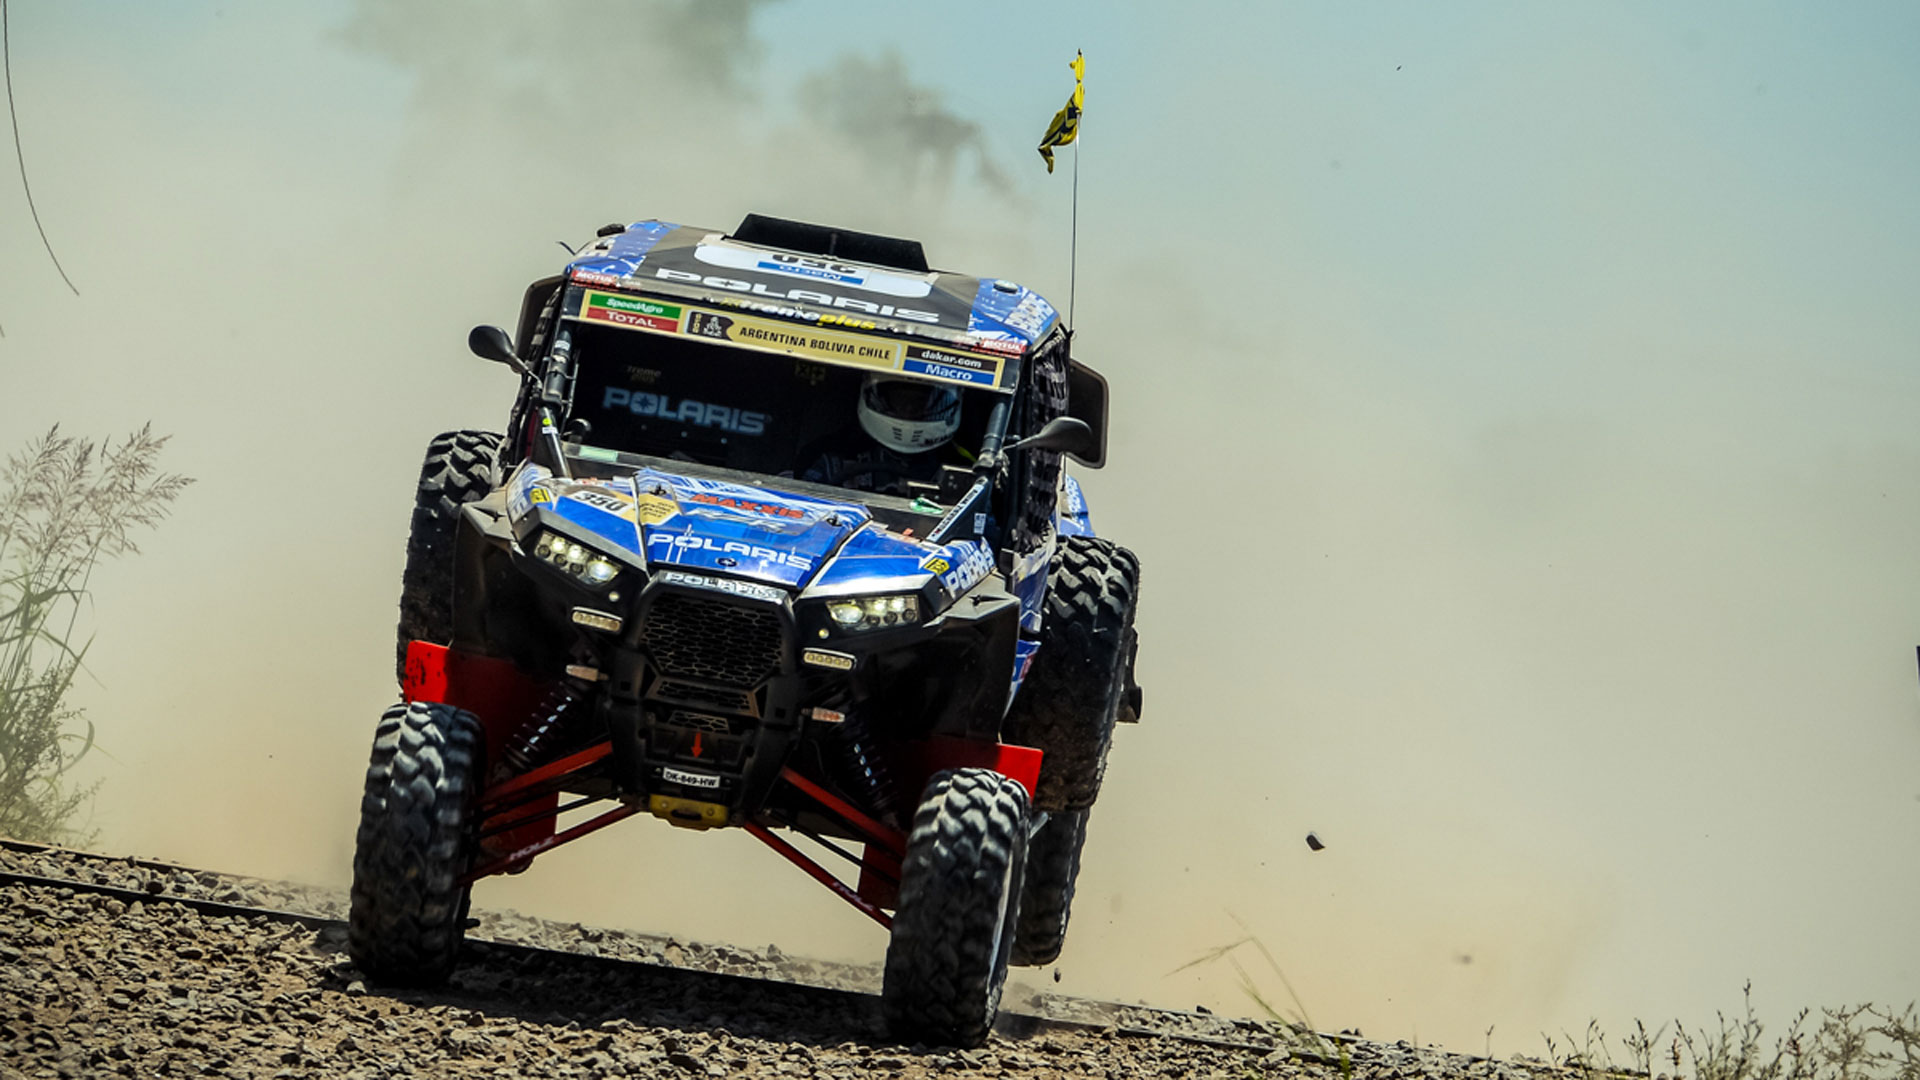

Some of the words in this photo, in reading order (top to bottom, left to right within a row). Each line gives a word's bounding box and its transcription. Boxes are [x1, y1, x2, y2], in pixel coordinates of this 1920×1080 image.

[606, 297, 664, 314] SpeedAgro
[655, 267, 940, 324] POLARIS
[739, 327, 806, 347] ARGENTINA
[810, 337, 854, 355] BOLIVIA
[859, 344, 890, 361] CHILE
[921, 350, 982, 368] dakar.com
[924, 363, 972, 382] Macro
[602, 386, 766, 436] POLARIS
[574, 491, 628, 512] 350
[689, 493, 804, 518] MAXXIS
[648, 533, 812, 571] POLARIS
[665, 572, 778, 601] POLARIS
